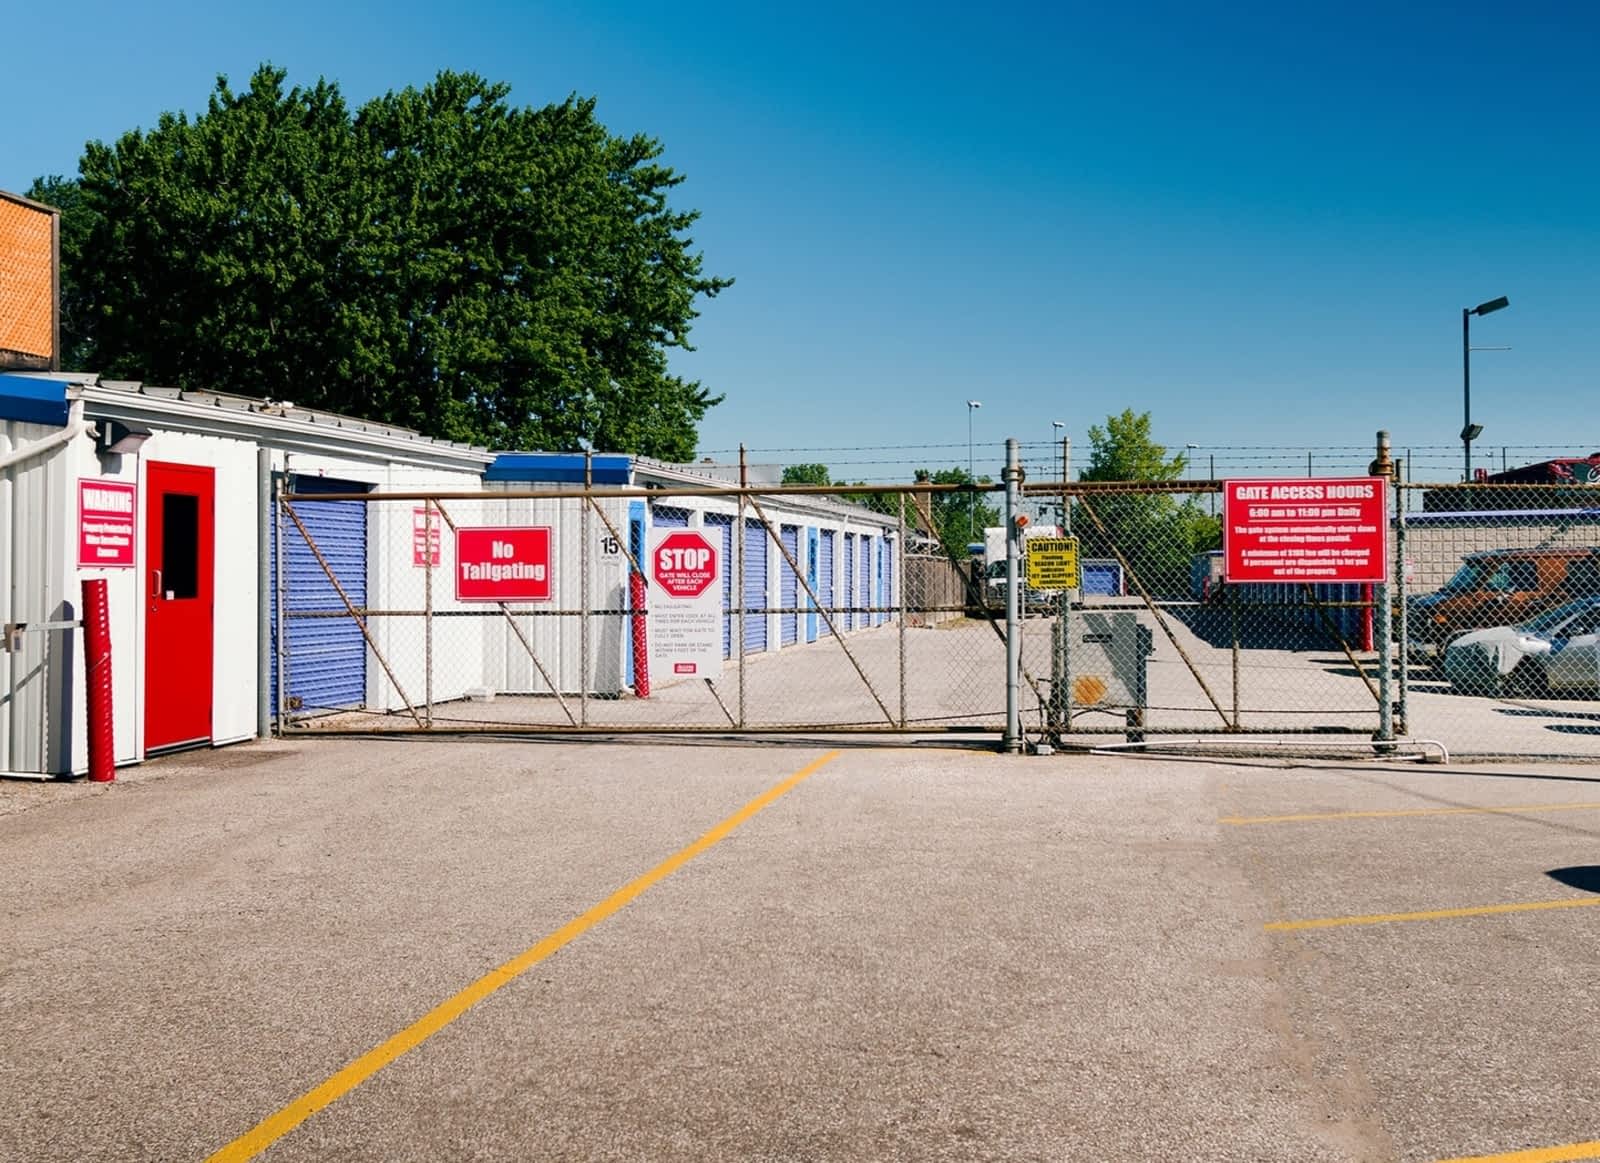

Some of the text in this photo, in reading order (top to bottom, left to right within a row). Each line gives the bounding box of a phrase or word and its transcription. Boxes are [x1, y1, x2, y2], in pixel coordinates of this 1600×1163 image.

[83, 488, 132, 512] WARNING
[1236, 485, 1374, 500] GATE ACCESS HOURS
[1322, 509, 1336, 518] pm
[1337, 507, 1360, 517] Daily
[492, 540, 514, 559] No
[600, 537, 618, 554] 15
[1032, 542, 1073, 552] CAUTION!
[1341, 548, 1370, 557] charged
[660, 548, 710, 570] STOP
[461, 562, 545, 582] Tailgating
